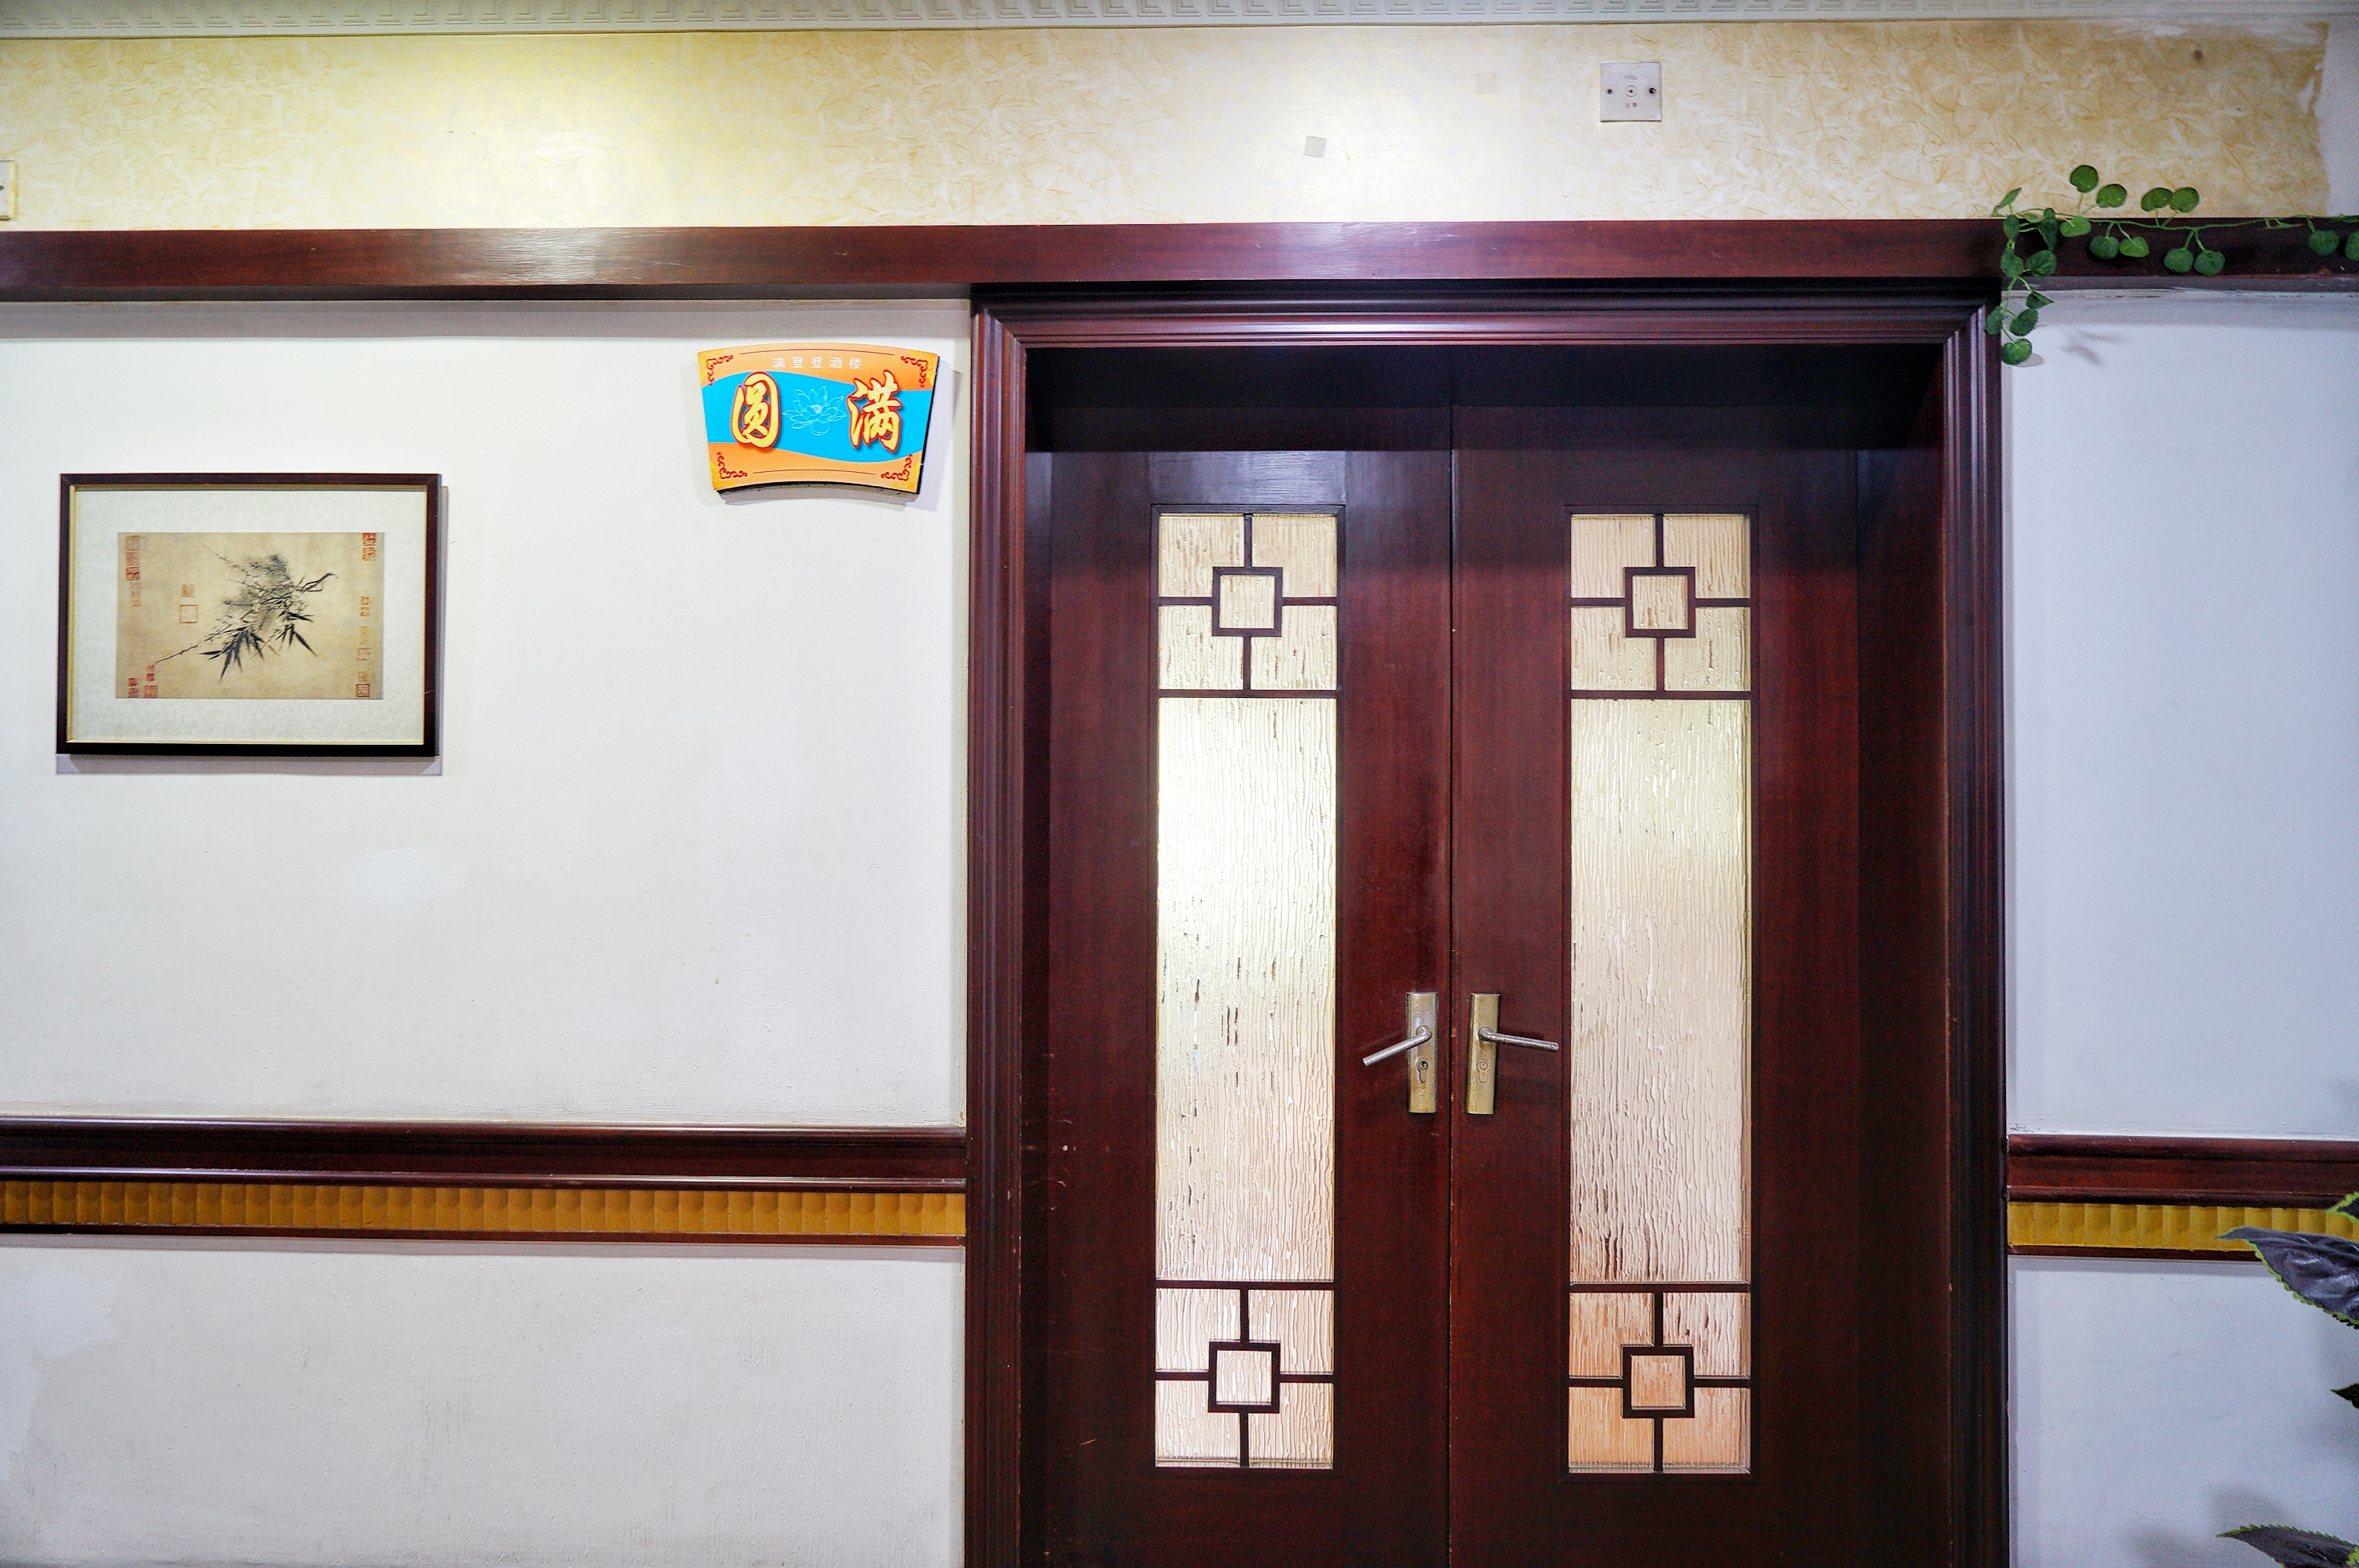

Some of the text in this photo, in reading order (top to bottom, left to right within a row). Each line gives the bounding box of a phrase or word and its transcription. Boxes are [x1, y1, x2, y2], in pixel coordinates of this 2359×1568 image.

[772, 356, 862, 369] 满登登酒楼
